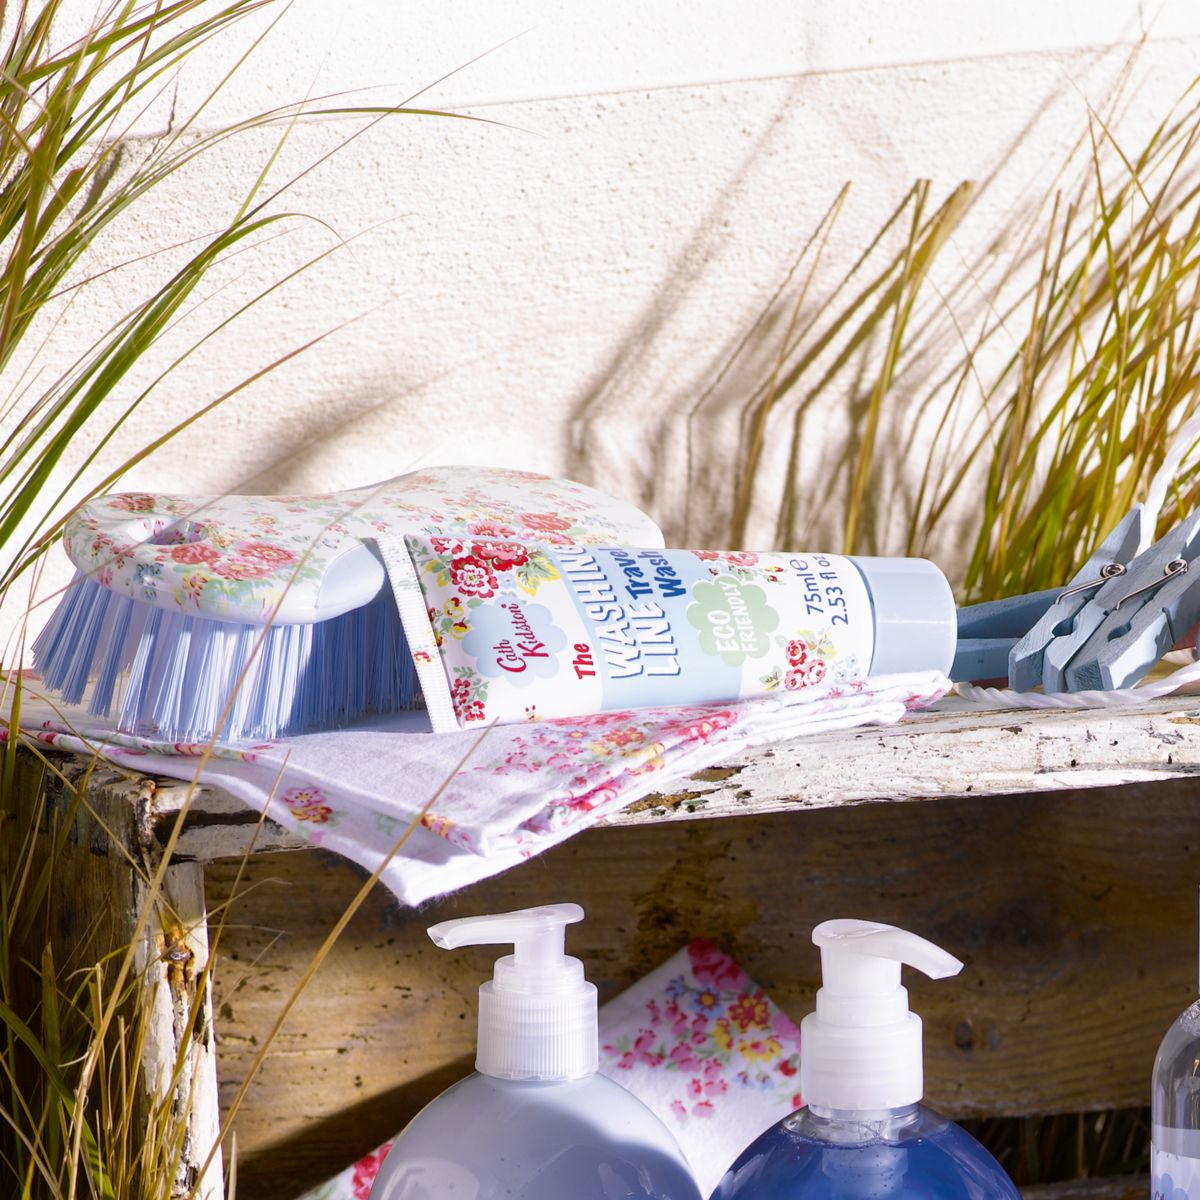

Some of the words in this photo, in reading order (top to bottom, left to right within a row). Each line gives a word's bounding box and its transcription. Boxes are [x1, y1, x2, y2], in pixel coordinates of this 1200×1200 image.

[598, 548, 653, 600] Travel
[637, 551, 687, 598] Wash
[812, 555, 831, 567] oz
[819, 571, 838, 580] fl
[549, 544, 644, 679] WASHING
[796, 573, 824, 615] 75ml
[825, 586, 849, 625] 2.53
[707, 610, 739, 652] ECO
[719, 581, 758, 652] FRIENDLY
[493, 639, 527, 673] Cath
[625, 602, 681, 676] LINE
[572, 643, 596, 680] The
